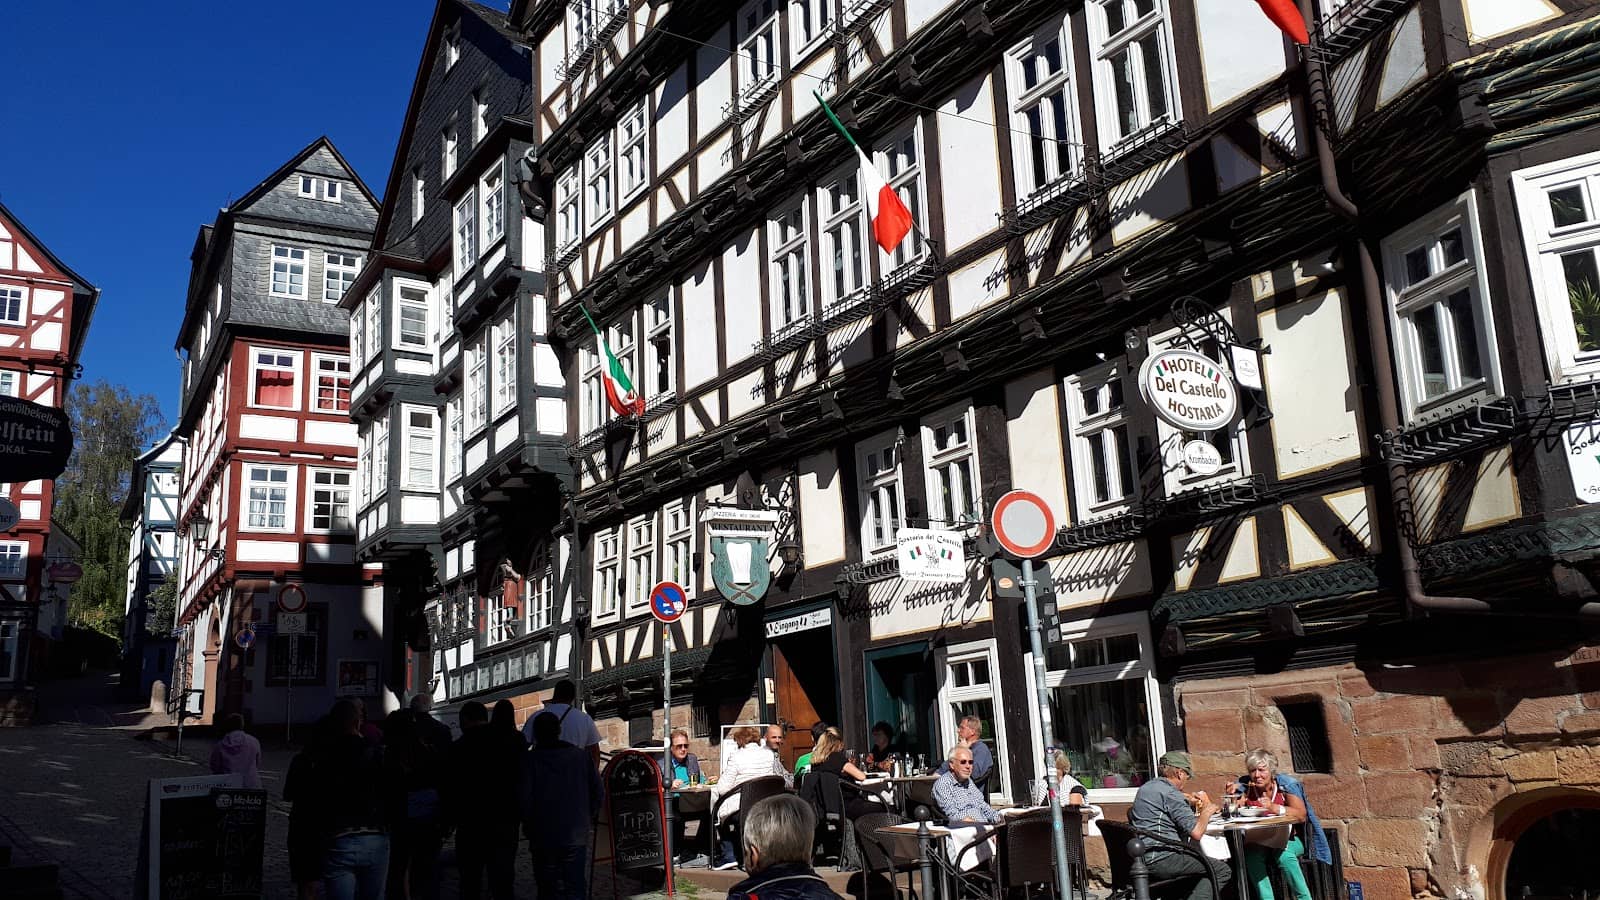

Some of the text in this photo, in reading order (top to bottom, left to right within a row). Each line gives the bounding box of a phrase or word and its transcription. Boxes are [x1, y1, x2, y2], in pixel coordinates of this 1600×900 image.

[1168, 358, 1207, 378] HOTEL
[1155, 376, 1227, 399] Del Castello
[0, 401, 61, 428] ewölbekeller
[1168, 398, 1225, 421] HOSTARIA
[711, 523, 768, 532] RESTAURANT
[774, 620, 799, 634] Eingang
